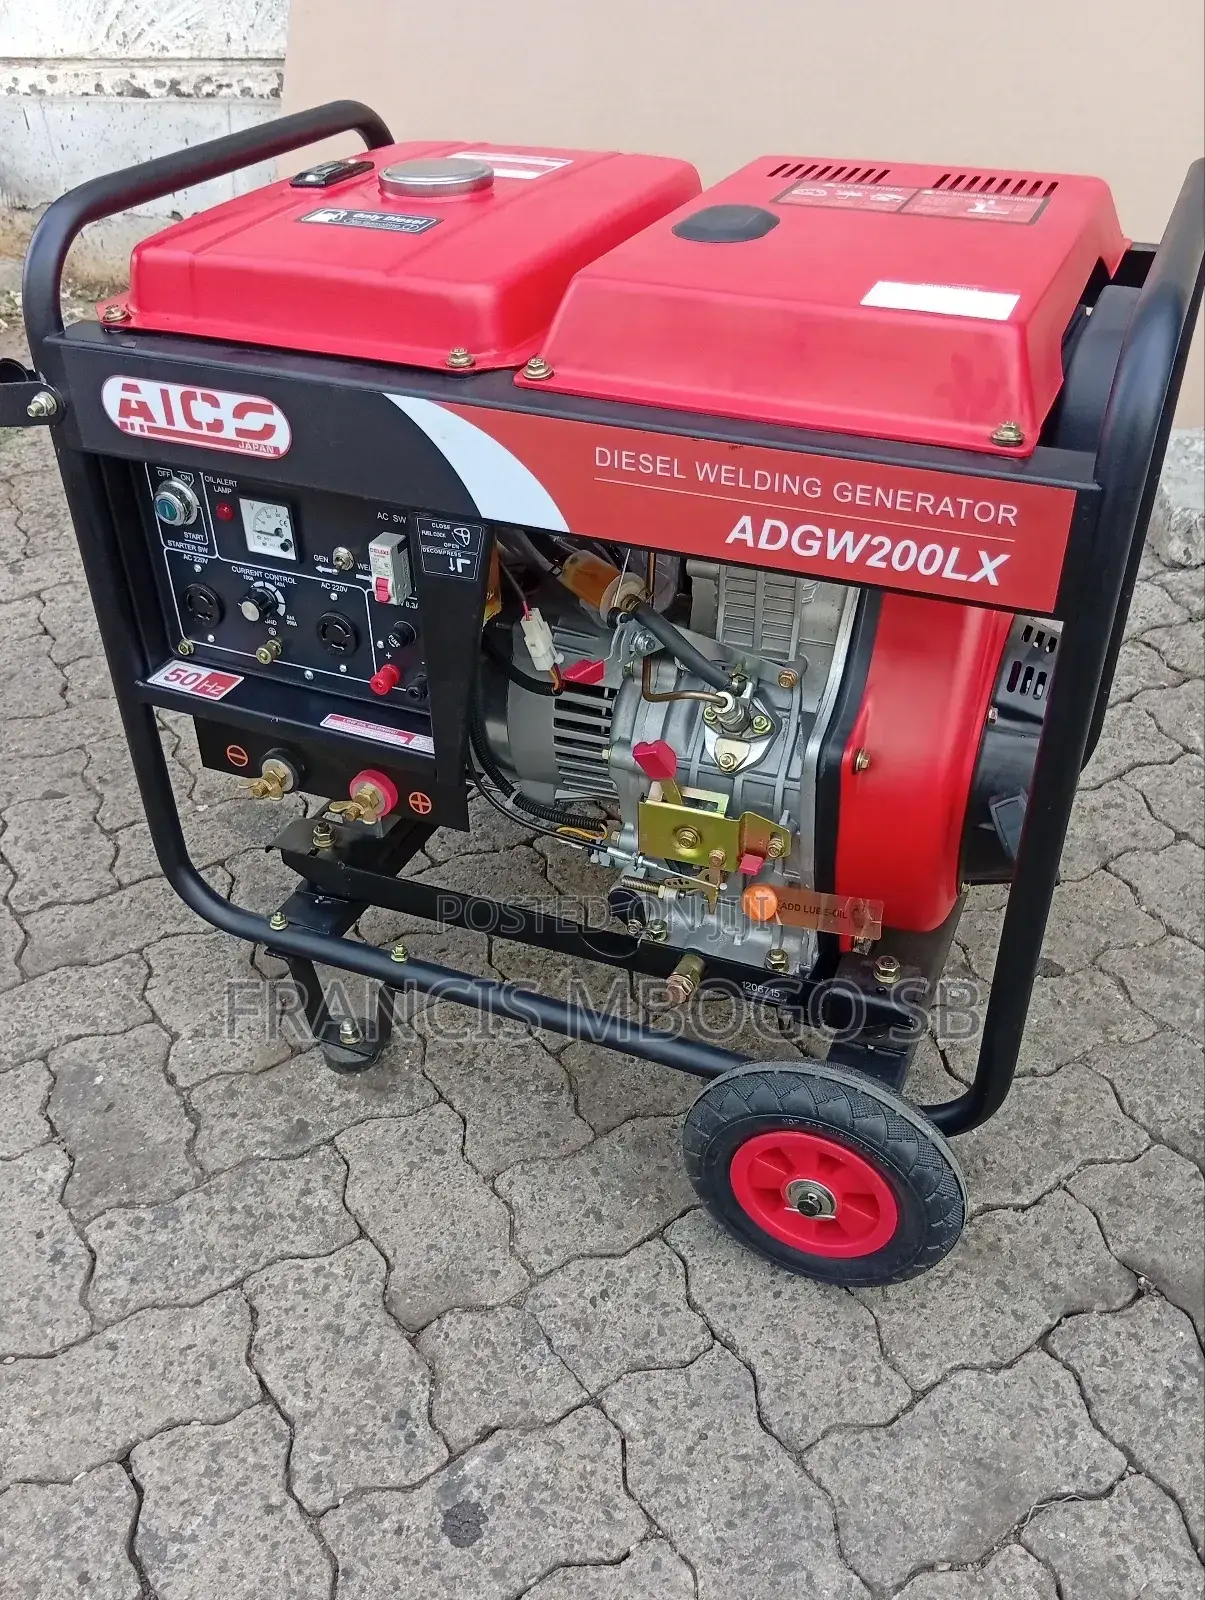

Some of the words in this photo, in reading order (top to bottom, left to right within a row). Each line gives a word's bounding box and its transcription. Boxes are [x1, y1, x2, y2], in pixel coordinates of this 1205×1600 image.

[837, 183, 903, 193] ATTENTION
[352, 212, 381, 222] Only
[384, 215, 428, 225] Diesel
[118, 383, 277, 442] AICS
[238, 440, 274, 455] JAPAN
[157, 469, 171, 478] OFF
[180, 473, 192, 482] ON
[204, 475, 217, 485] OIL
[217, 476, 238, 488] ALERT
[594, 446, 687, 480] DIESEL
[694, 460, 823, 499] WELDING
[832, 481, 1019, 528] GENERATOR
[213, 485, 233, 495] LAMP
[376, 511, 389, 522] AC
[392, 514, 407, 524] SW
[431, 522, 451, 530] CLOSE
[183, 531, 204, 541] START
[433, 531, 447, 539] COCK
[167, 540, 198, 552] STARTER
[198, 545, 208, 554] SW
[422, 547, 462, 557] DECOMPRESS
[443, 542, 460, 550] OPEN
[725, 514, 1011, 587] ADGW200LX
[183, 553, 194, 561] AC
[193, 556, 209, 565] 220V
[313, 554, 329, 564] GEN
[356, 562, 372, 572] WEL
[231, 565, 264, 579] CURRENT
[264, 571, 297, 585] CONTROL
[320, 582, 331, 590] AC
[331, 584, 348, 594] 220V
[388, 634, 401, 648] FUSE
[163, 667, 203, 687] 50
[197, 680, 225, 695] Hz
[781, 902, 801, 912] ADD
[803, 904, 848, 919] LUBE-OIL
[741, 980, 781, 998] 1206715
